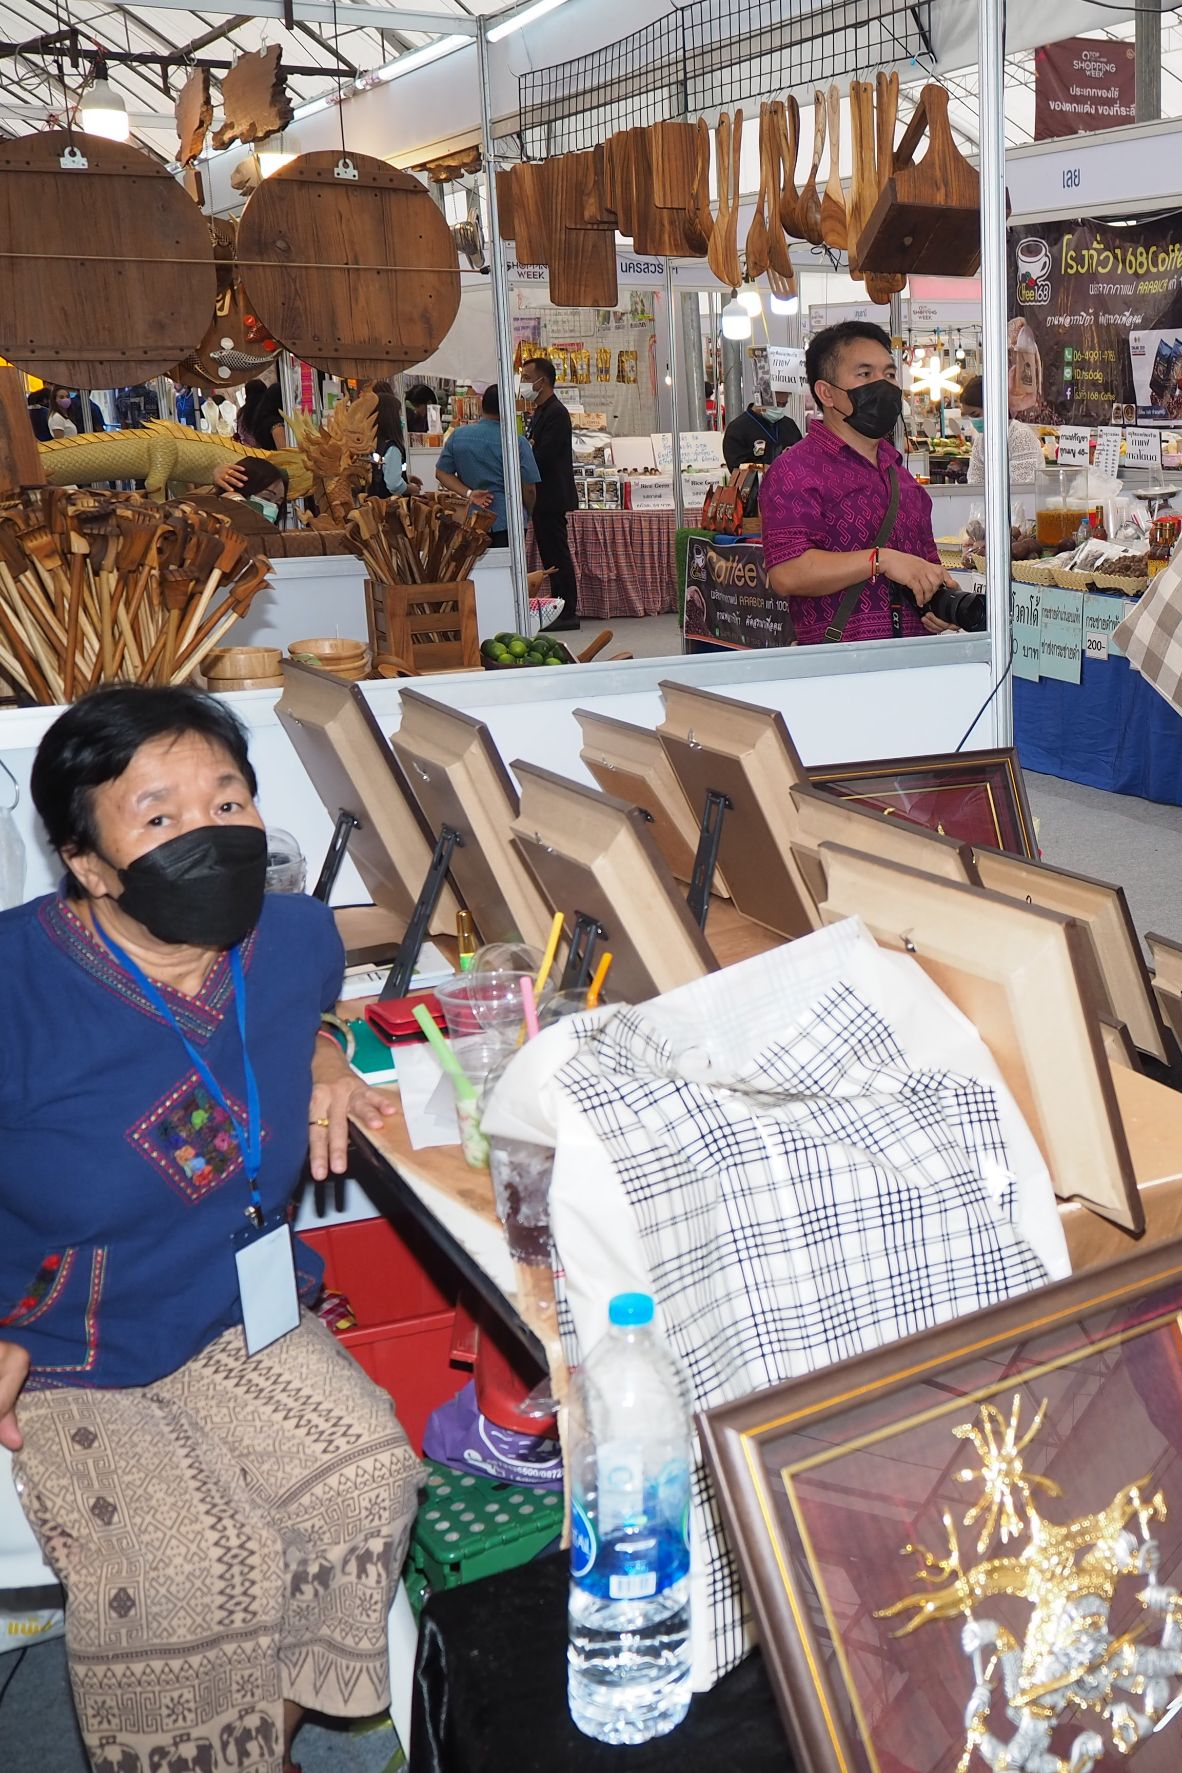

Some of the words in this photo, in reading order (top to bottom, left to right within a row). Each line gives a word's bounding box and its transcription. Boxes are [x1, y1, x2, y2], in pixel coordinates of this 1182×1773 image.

[1073, 60, 1116, 73] SHOPPING
[1085, 70, 1104, 78] WEEK
[1063, 168, 1081, 189] เลย
[517, 270, 545, 280] WEEK
[706, 550, 757, 588] Coffee
